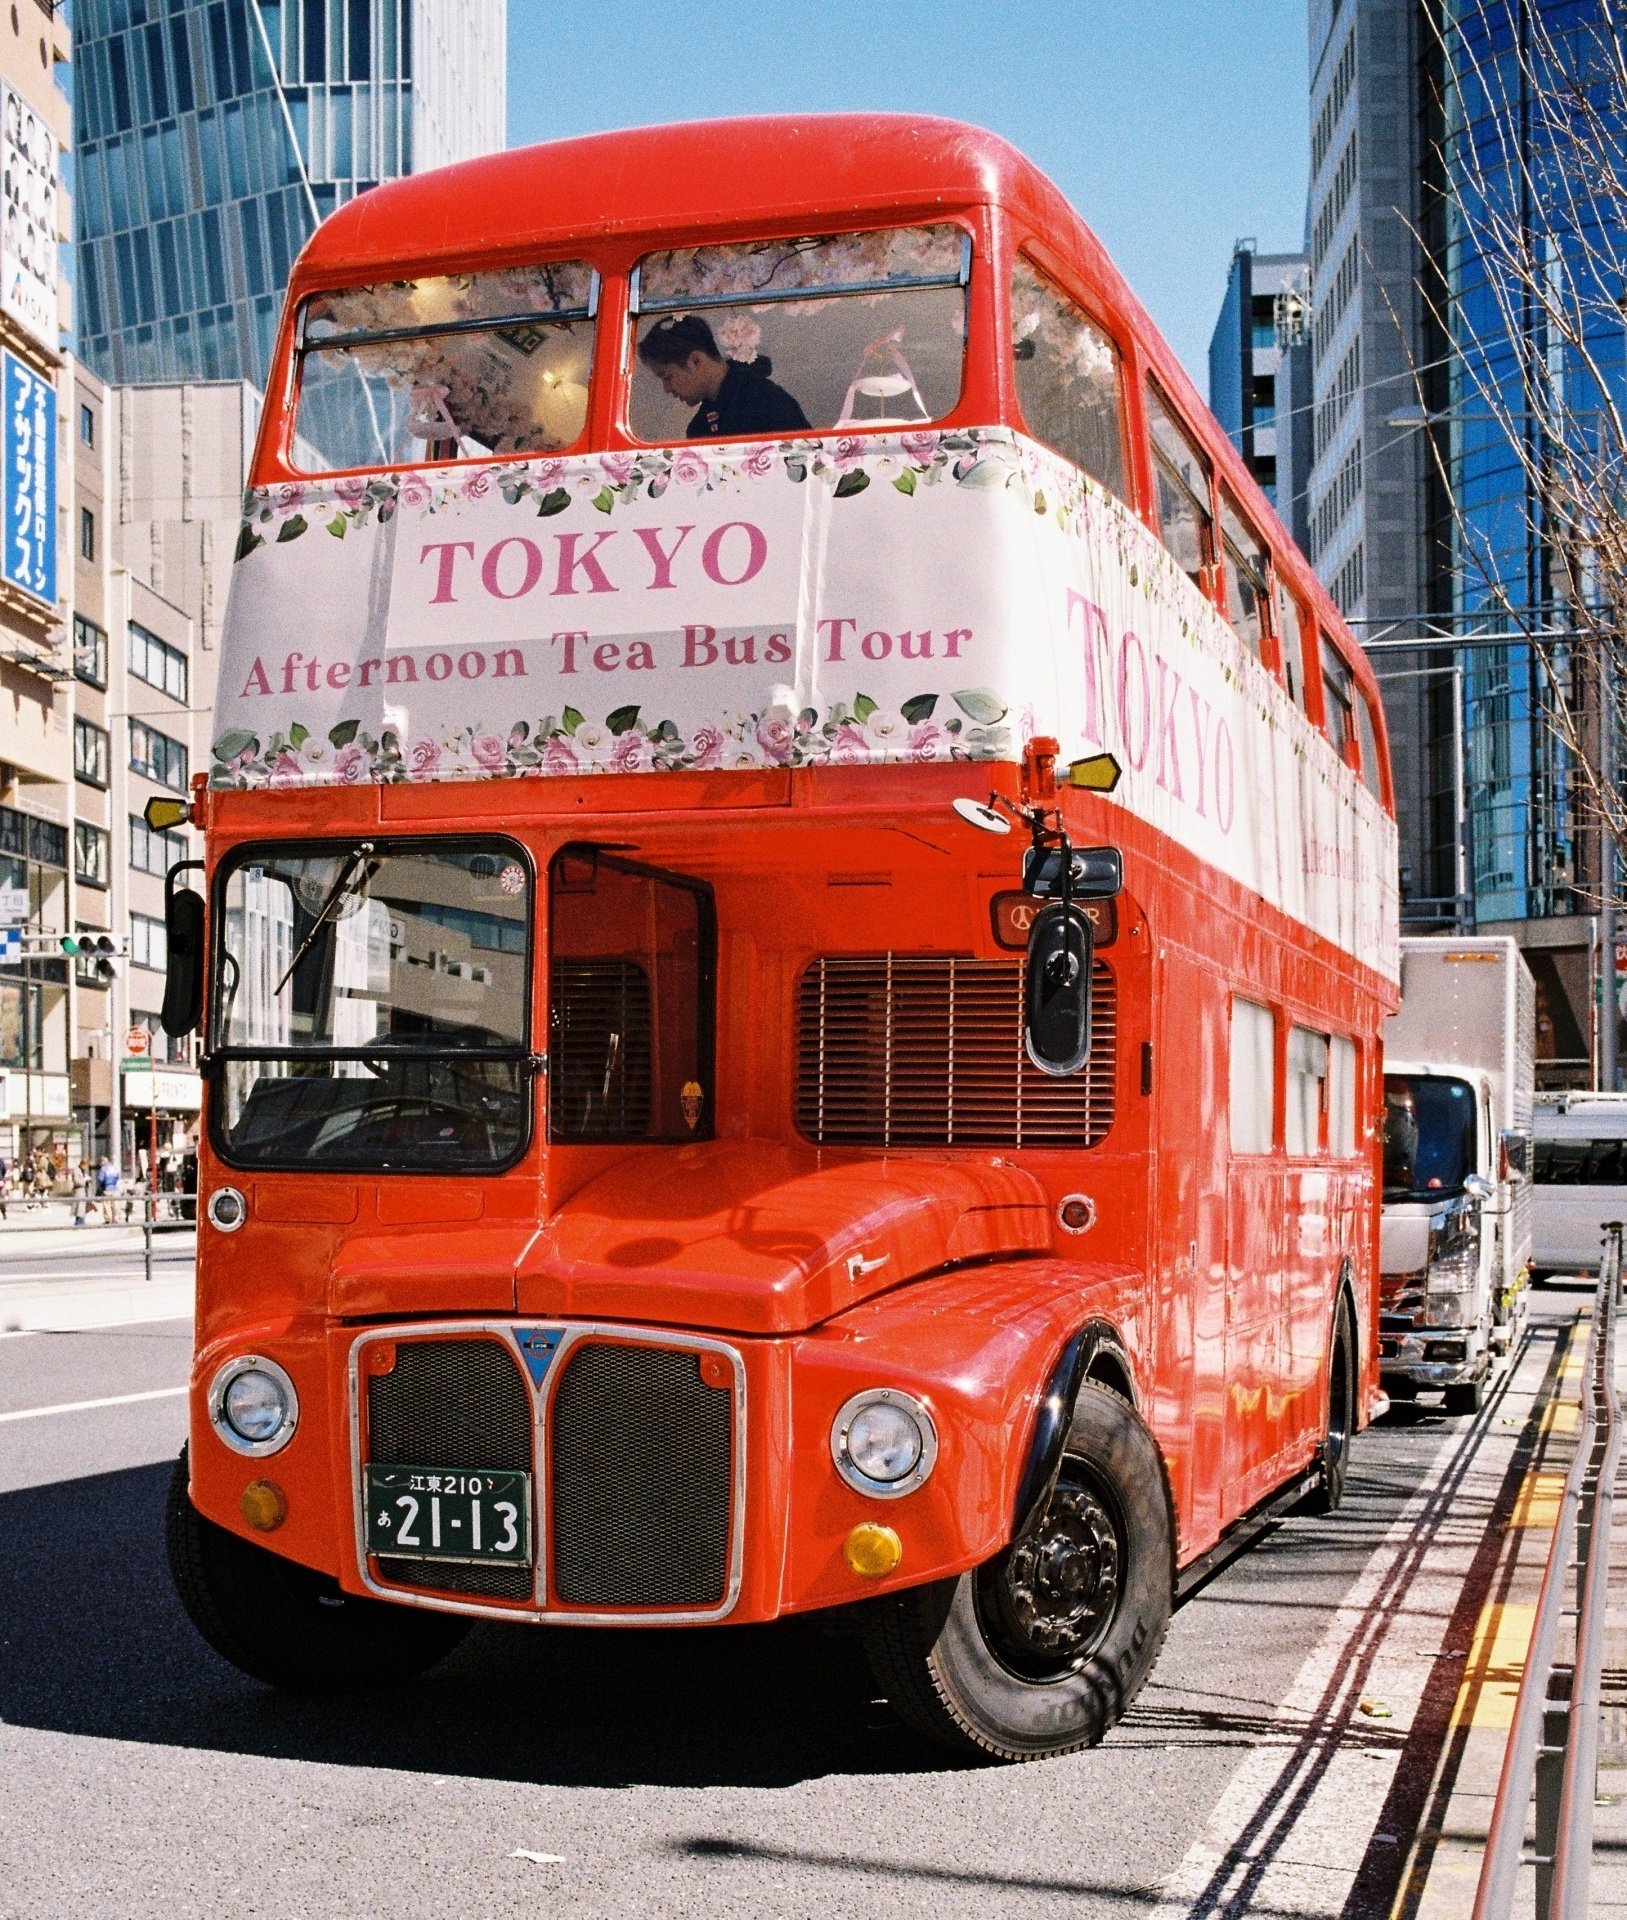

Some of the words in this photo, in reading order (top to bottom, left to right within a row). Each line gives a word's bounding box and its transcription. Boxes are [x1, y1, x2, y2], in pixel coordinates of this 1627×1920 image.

[14, 364, 31, 586] アサックス
[34, 381, 46, 592] 不ローン
[419, 521, 768, 605] TOKYO
[238, 647, 529, 698] Afternoon
[551, 631, 657, 674] Tea
[680, 623, 792, 668] Bus
[816, 618, 974, 663] Tour
[1066, 586, 1235, 837] TOKYO
[377, 1510, 392, 1528] あ
[396, 1495, 518, 1552] 21-13
[409, 1474, 482, 1496] 江東210
